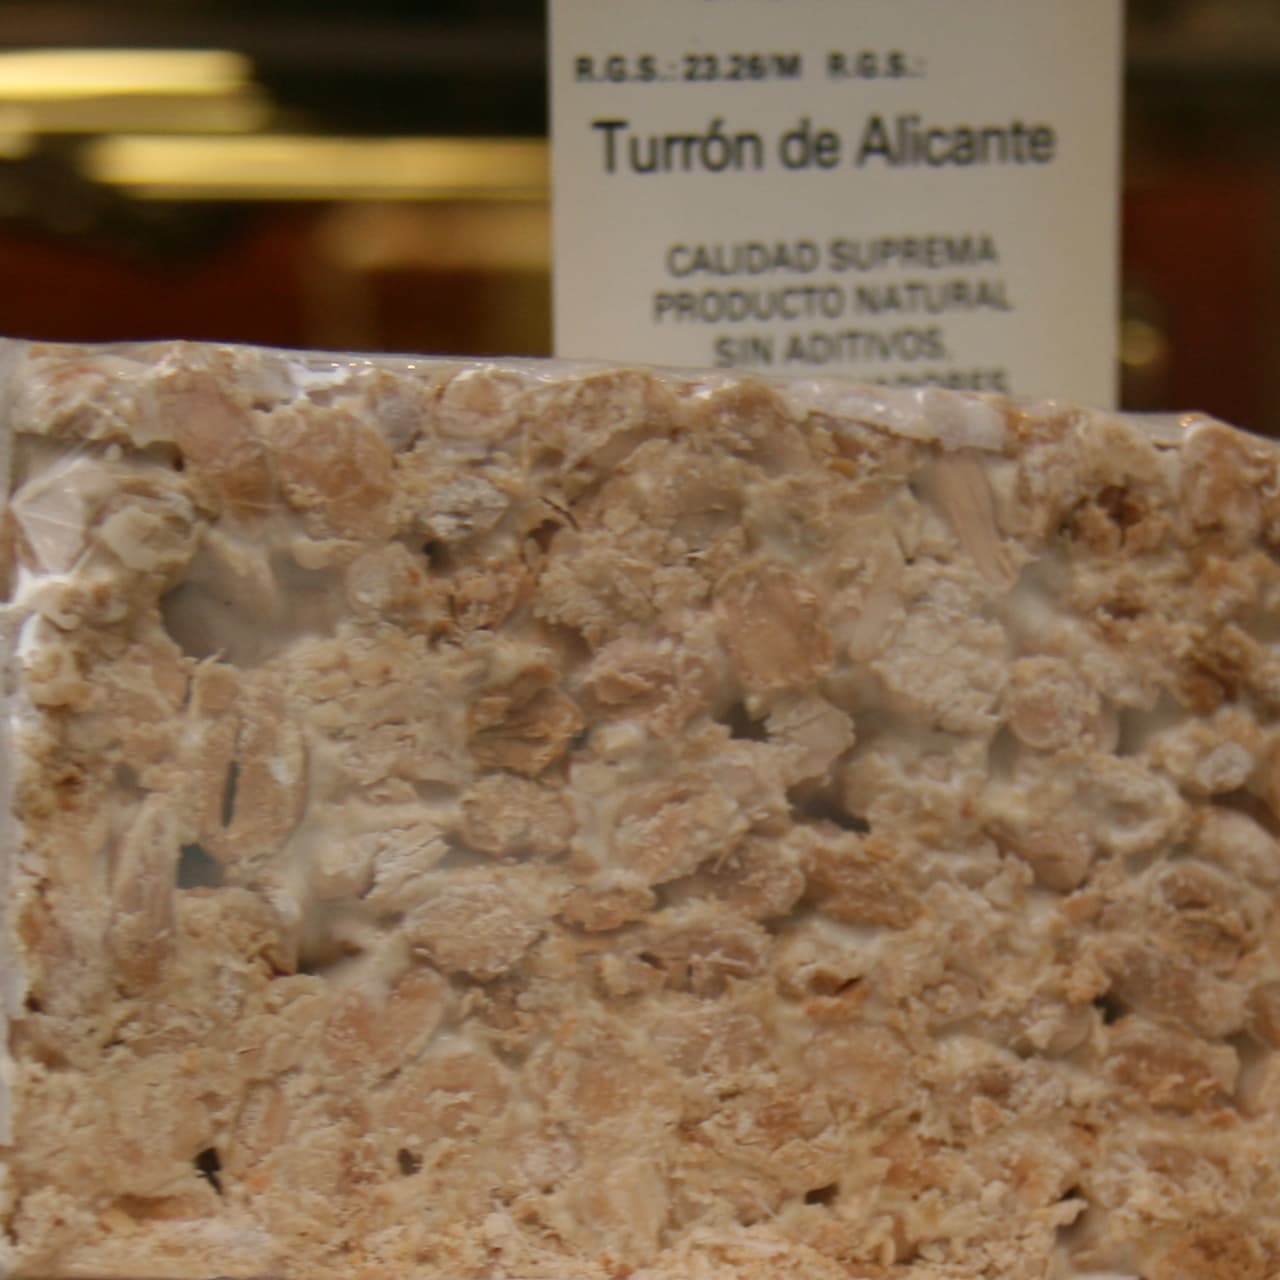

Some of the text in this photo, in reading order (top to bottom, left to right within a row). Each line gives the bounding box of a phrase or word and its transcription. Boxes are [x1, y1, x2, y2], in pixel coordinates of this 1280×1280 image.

[591, 112, 1056, 174] Turrón de Alicante
[667, 232, 999, 278] CALIDAD SUPREMA
[654, 278, 1012, 324] PRODUCTO NATURAL
[714, 333, 773, 370] SIN
